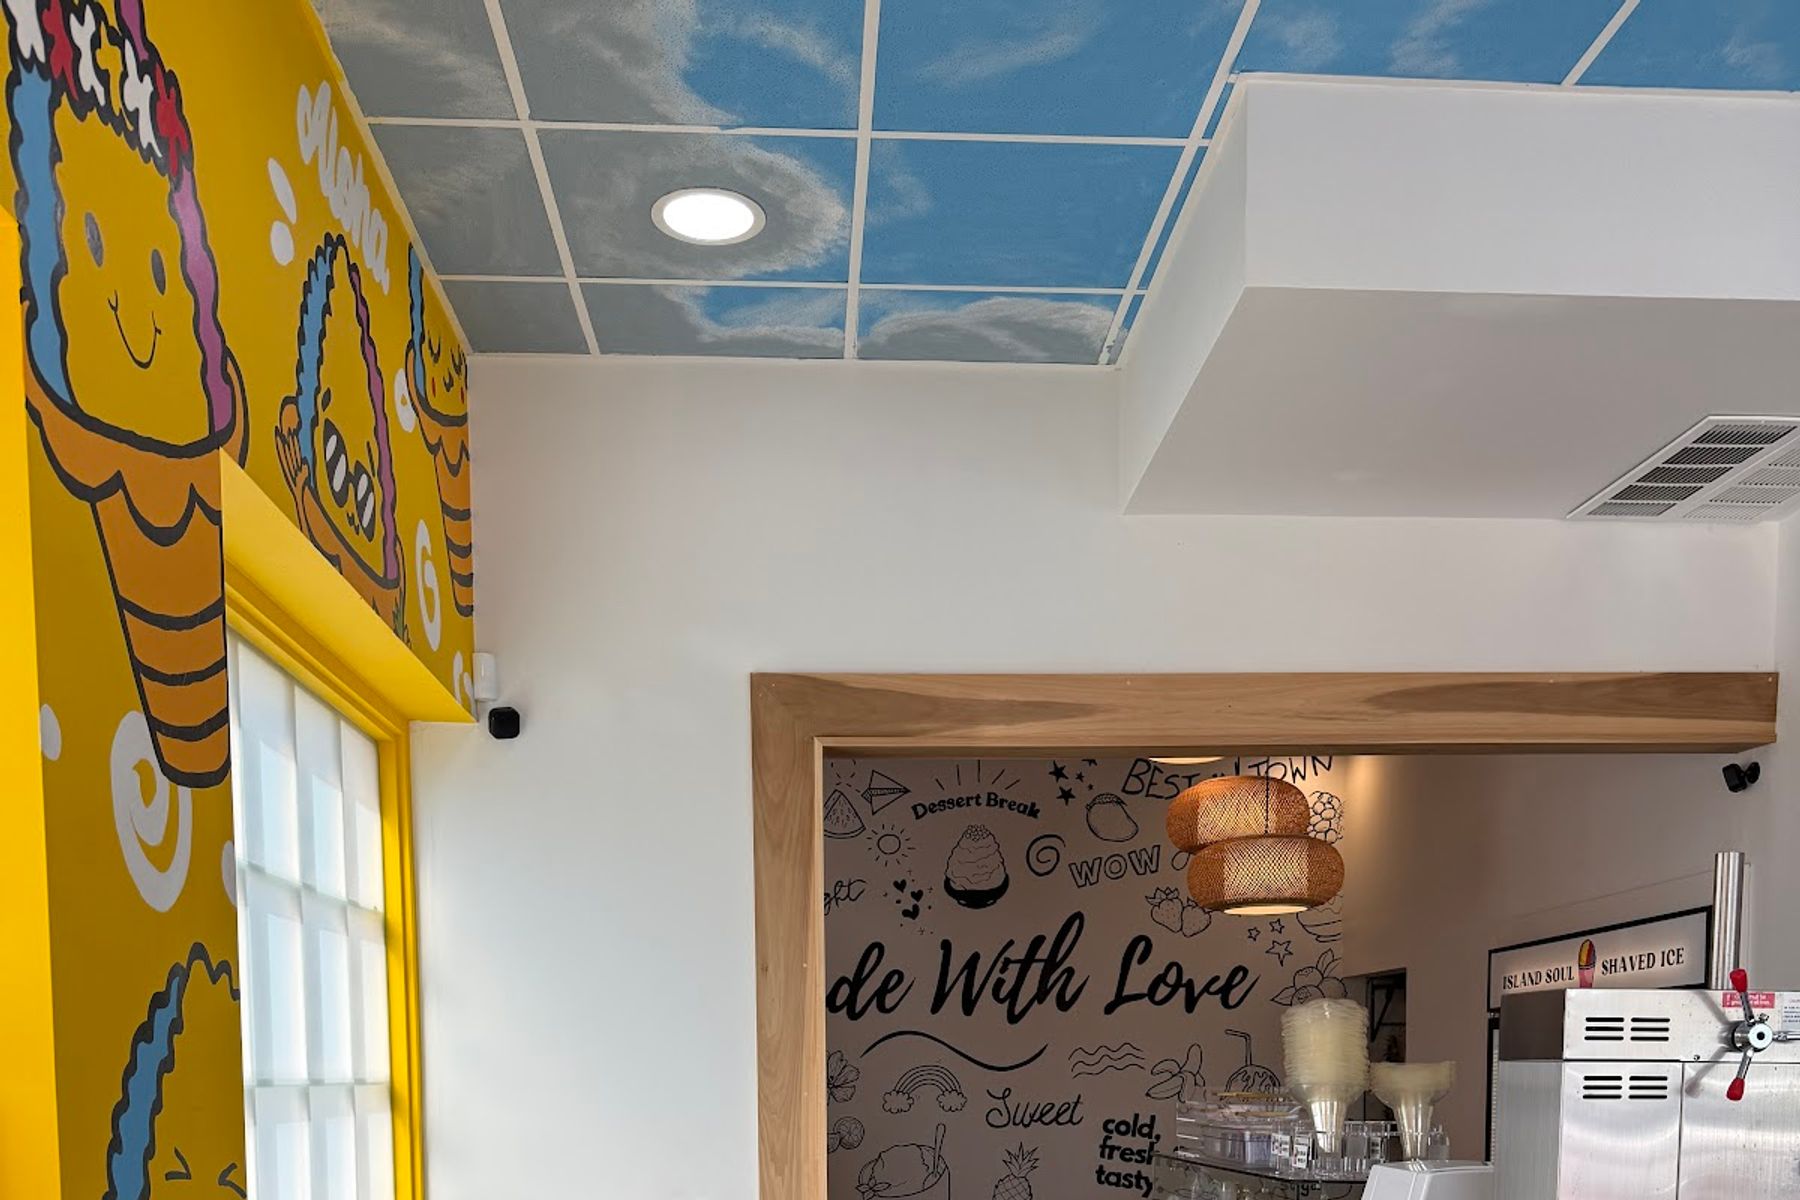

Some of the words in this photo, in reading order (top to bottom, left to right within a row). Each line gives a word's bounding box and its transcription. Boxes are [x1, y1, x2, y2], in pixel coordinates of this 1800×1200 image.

[1121, 758, 1199, 799] BEST
[911, 793, 982, 820] Dessert
[986, 791, 1041, 819] Break
[1069, 844, 1160, 888] WOW
[930, 911, 1090, 1025] With
[1103, 935, 1260, 1015] Love
[1503, 970, 1542, 990] ISLAND
[1545, 966, 1575, 984] SOUL
[1601, 952, 1656, 976] SHAVED
[1660, 948, 1685, 968] ICE
[986, 1087, 1085, 1129] Sweet
[1102, 1113, 1161, 1144] cold,
[1096, 1165, 1153, 1198] tasty
